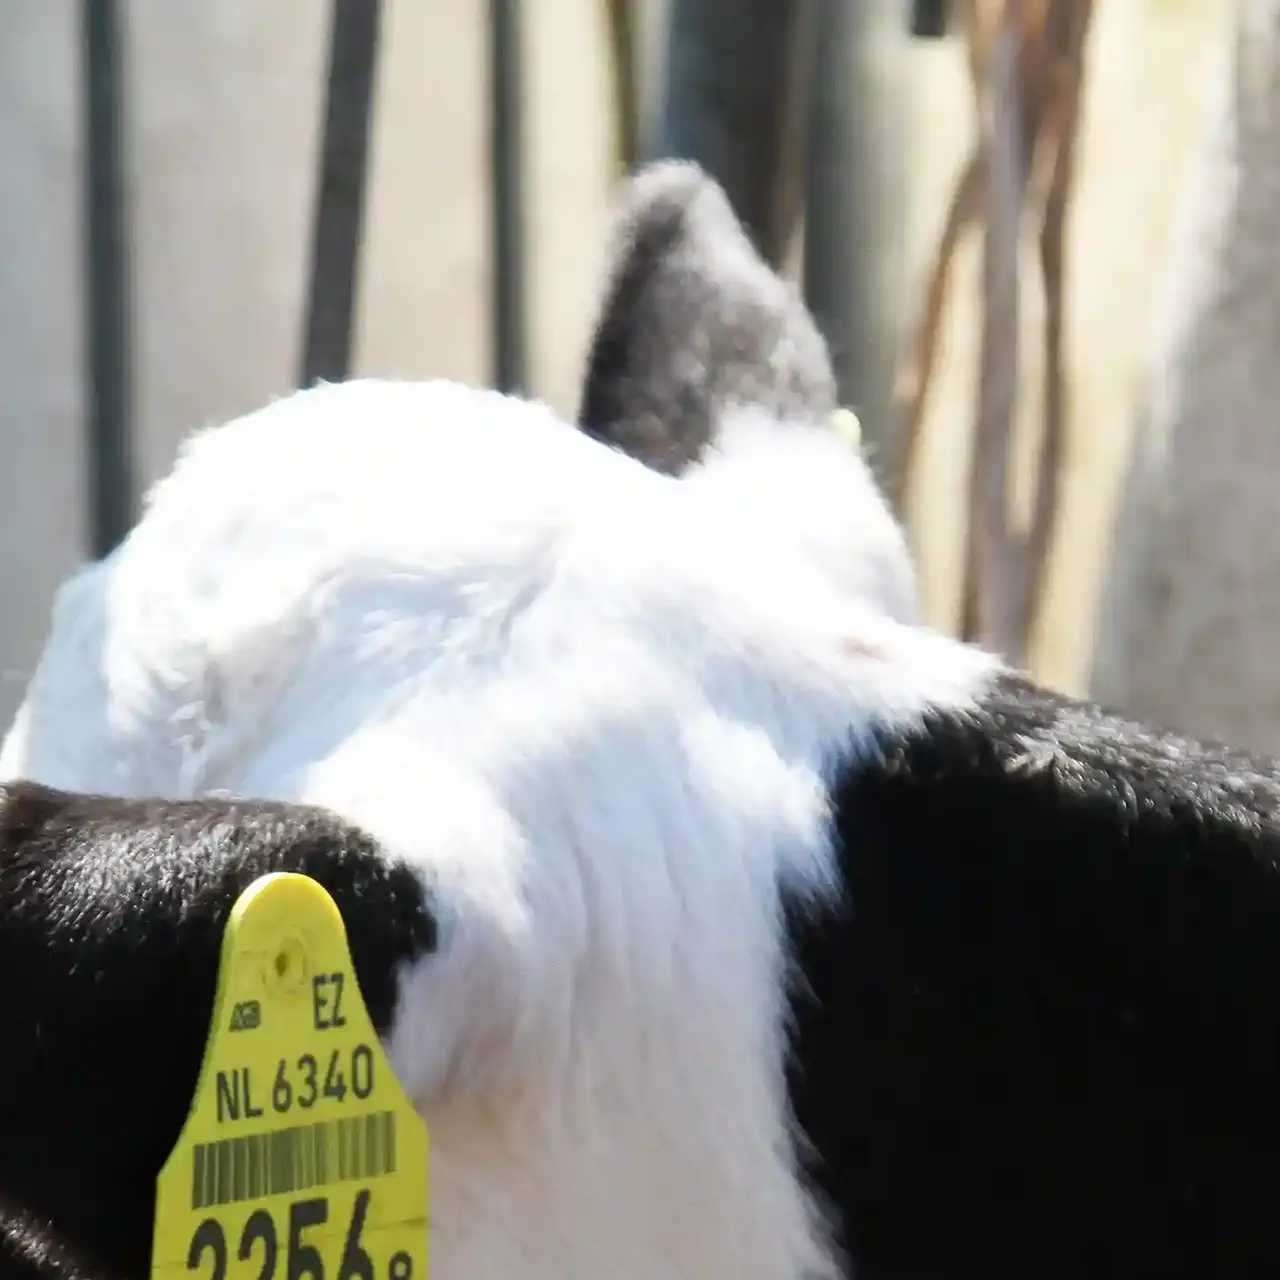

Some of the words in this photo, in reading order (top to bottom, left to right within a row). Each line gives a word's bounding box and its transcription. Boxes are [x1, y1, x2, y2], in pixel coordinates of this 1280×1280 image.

[313, 972, 346, 1030] EZ
[216, 1067, 264, 1123] NL
[272, 1043, 374, 1113] 6340
